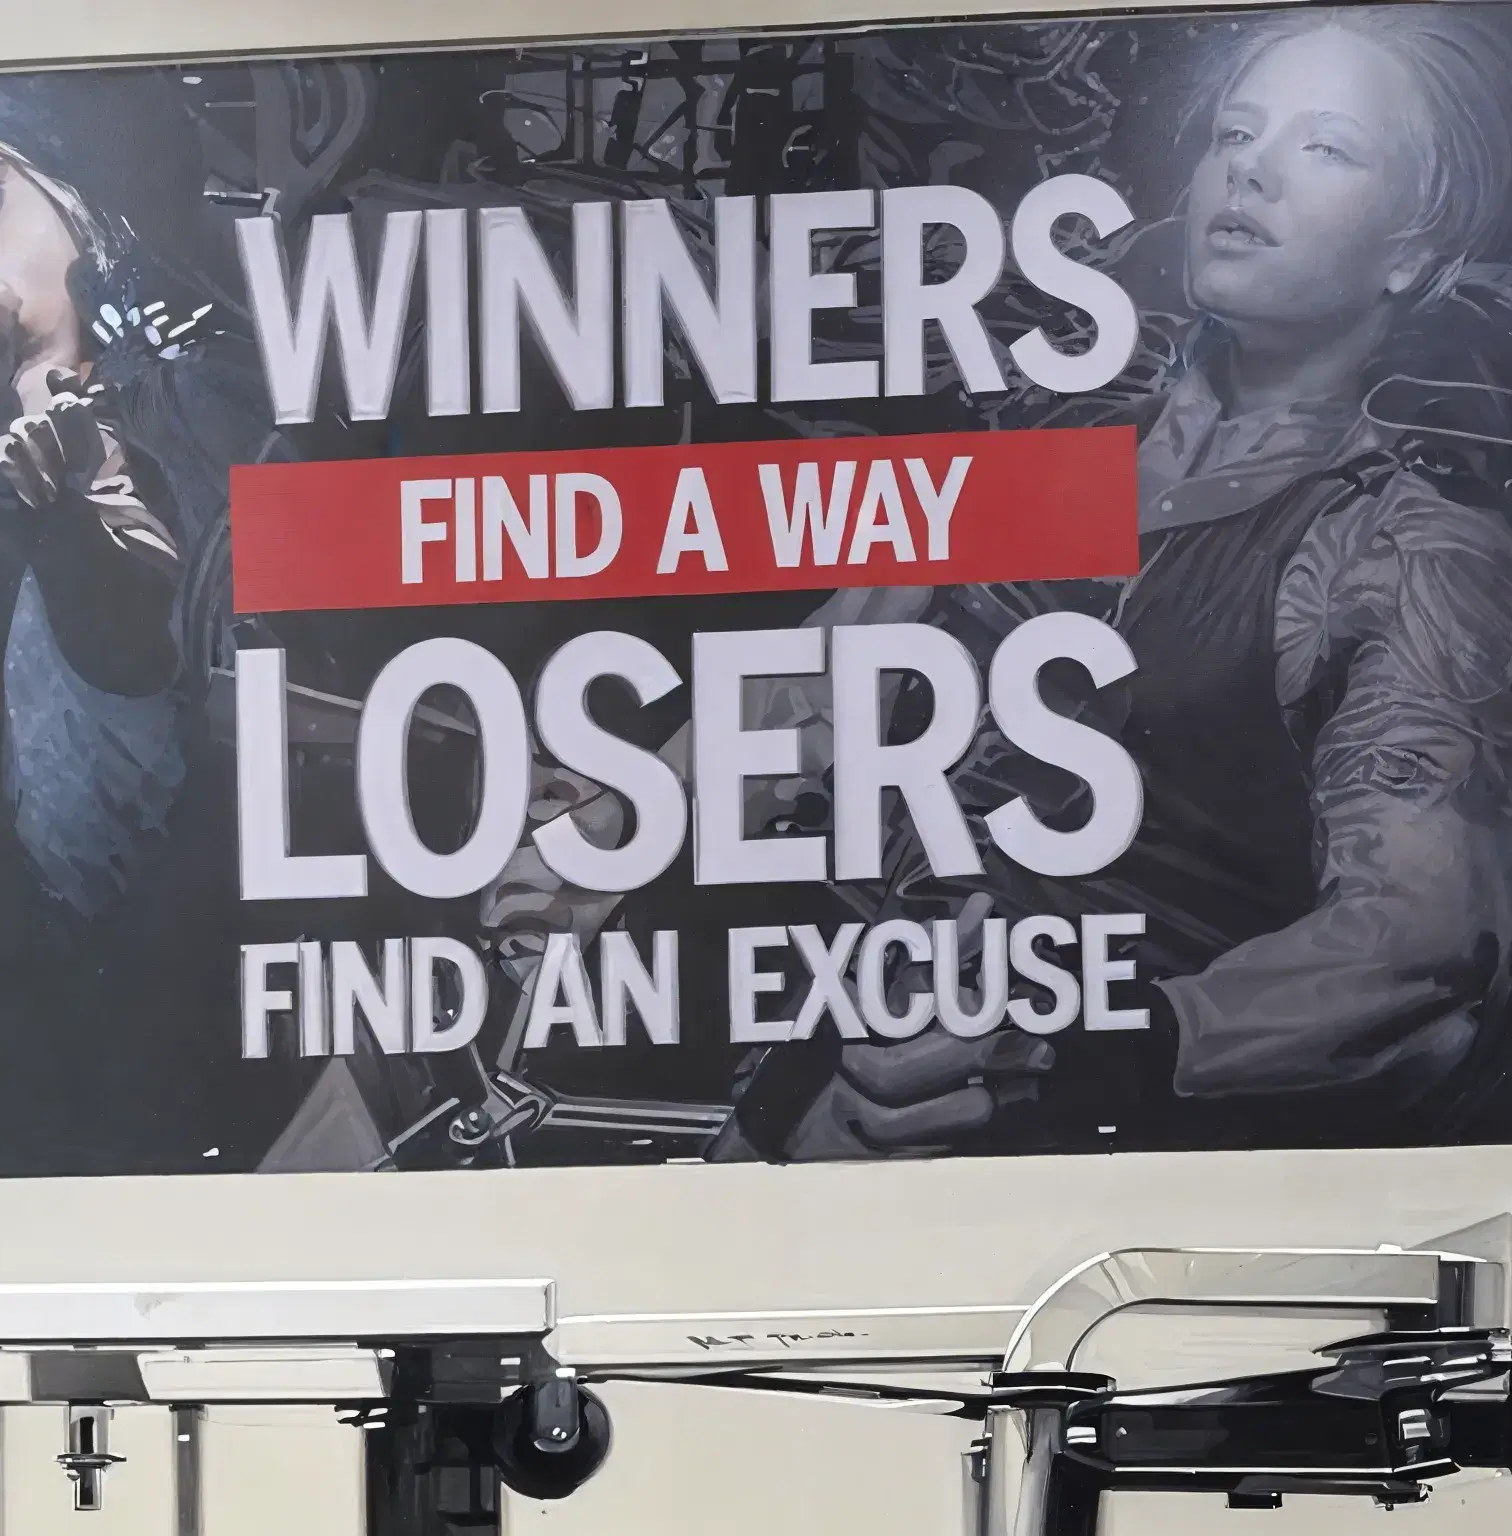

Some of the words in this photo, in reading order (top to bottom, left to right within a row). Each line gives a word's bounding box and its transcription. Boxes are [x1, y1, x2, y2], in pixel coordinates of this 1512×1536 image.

[234, 173, 1139, 426] WINNERS
[399, 473, 624, 585] FIND
[655, 467, 729, 575] A
[757, 456, 974, 568] WAY
[234, 611, 1144, 901] LOSERS
[239, 936, 489, 1060] FIND
[524, 929, 680, 1049] AN
[728, 912, 1152, 1043] EXCUSE
